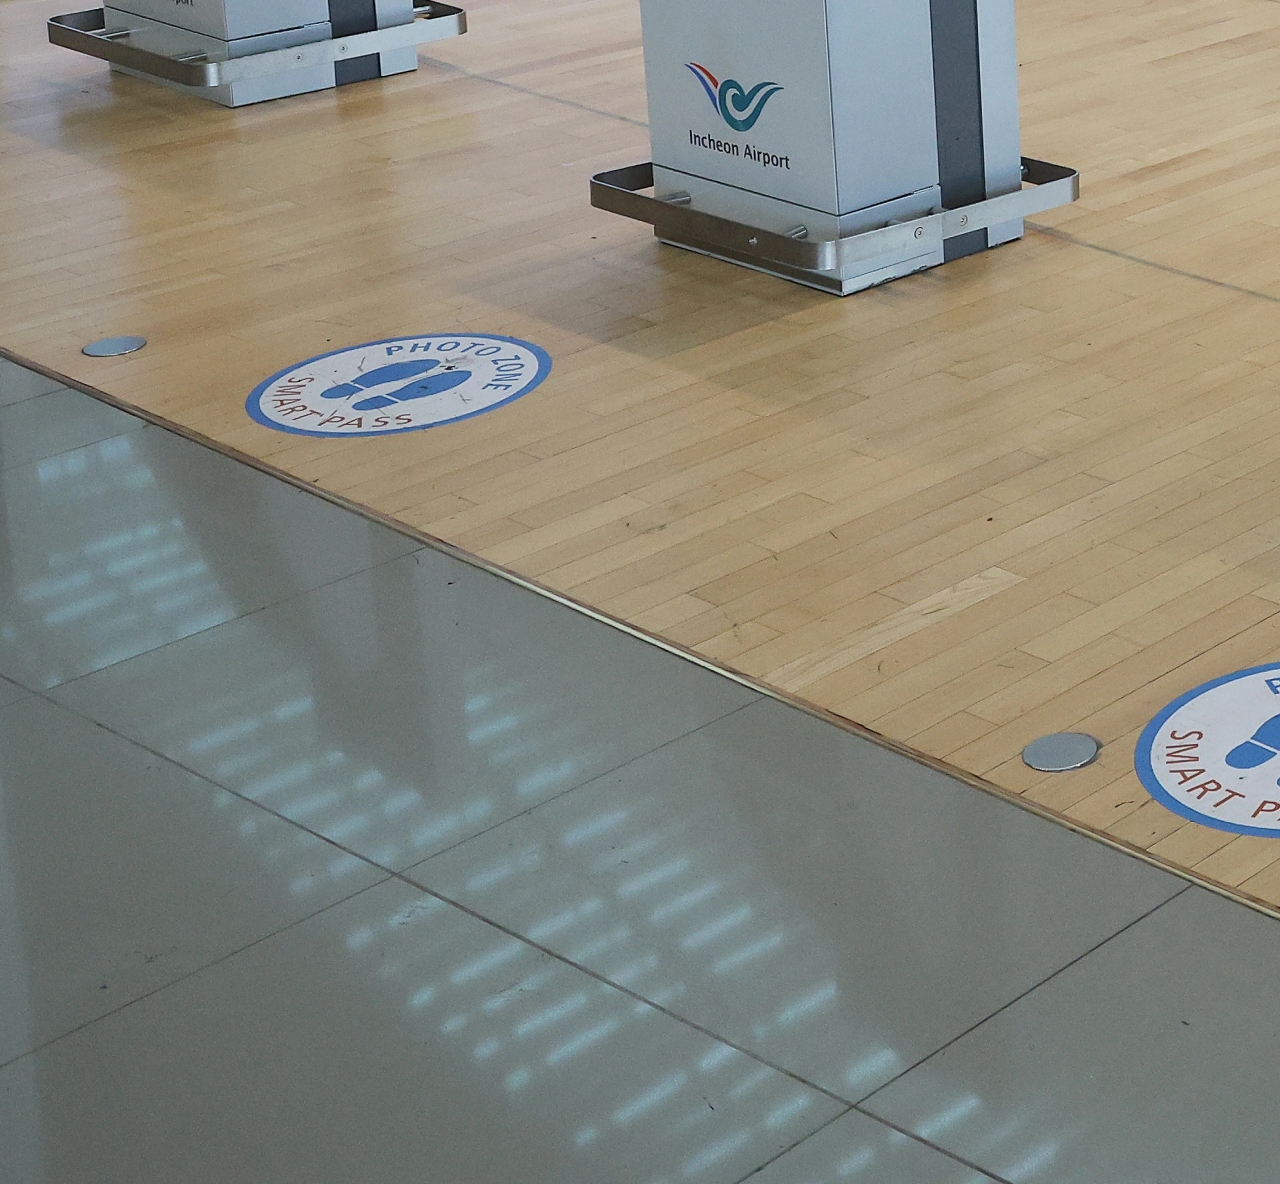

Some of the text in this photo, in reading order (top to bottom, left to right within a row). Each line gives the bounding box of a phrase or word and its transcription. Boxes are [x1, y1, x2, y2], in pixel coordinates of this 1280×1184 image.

[689, 129, 790, 170] Incheon Airport
[385, 341, 525, 392] PHOTO ZONE
[272, 376, 413, 429] SMART PASS
[1165, 730, 1246, 809] SMART
